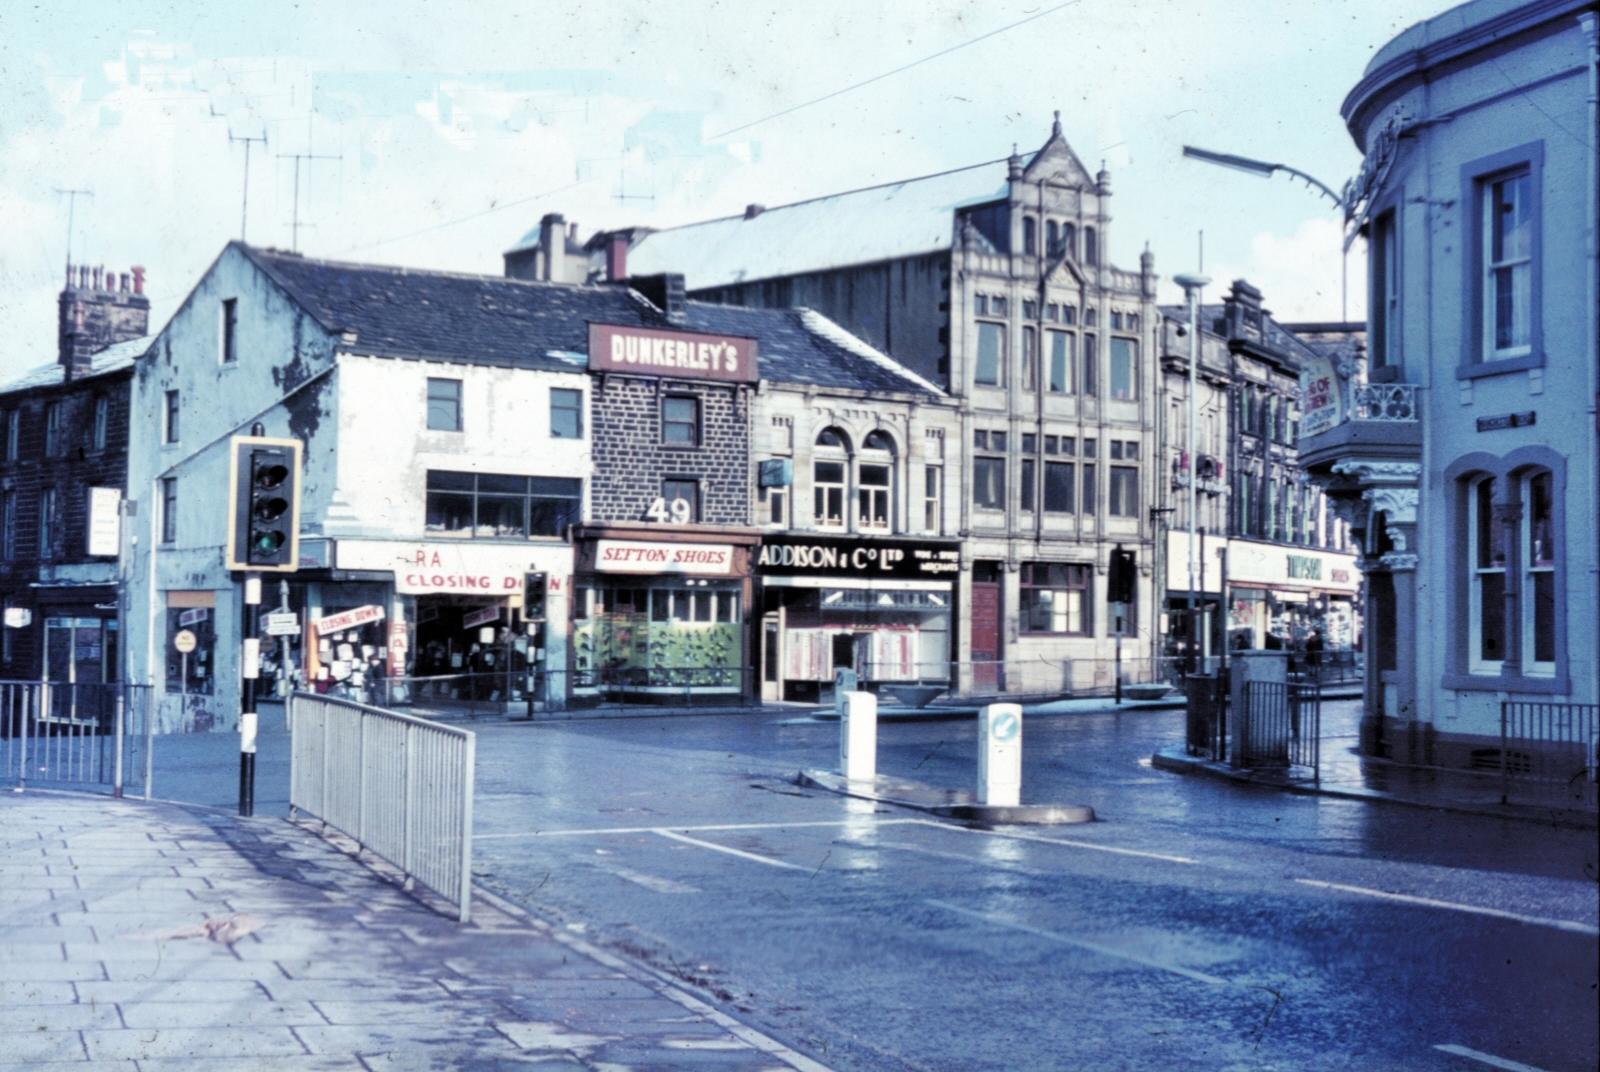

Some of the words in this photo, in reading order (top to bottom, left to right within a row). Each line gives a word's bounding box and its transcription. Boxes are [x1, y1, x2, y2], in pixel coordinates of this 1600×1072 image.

[611, 334, 738, 373] DUNKERLEY'S
[647, 497, 690, 526] 49
[672, 549, 726, 565] SHOES
[758, 544, 838, 568] ADDISON
[405, 574, 491, 589] CLOSING
[503, 576, 561, 591] DN
[321, 614, 352, 632] CLOSING
[355, 606, 378, 622] DOWN
